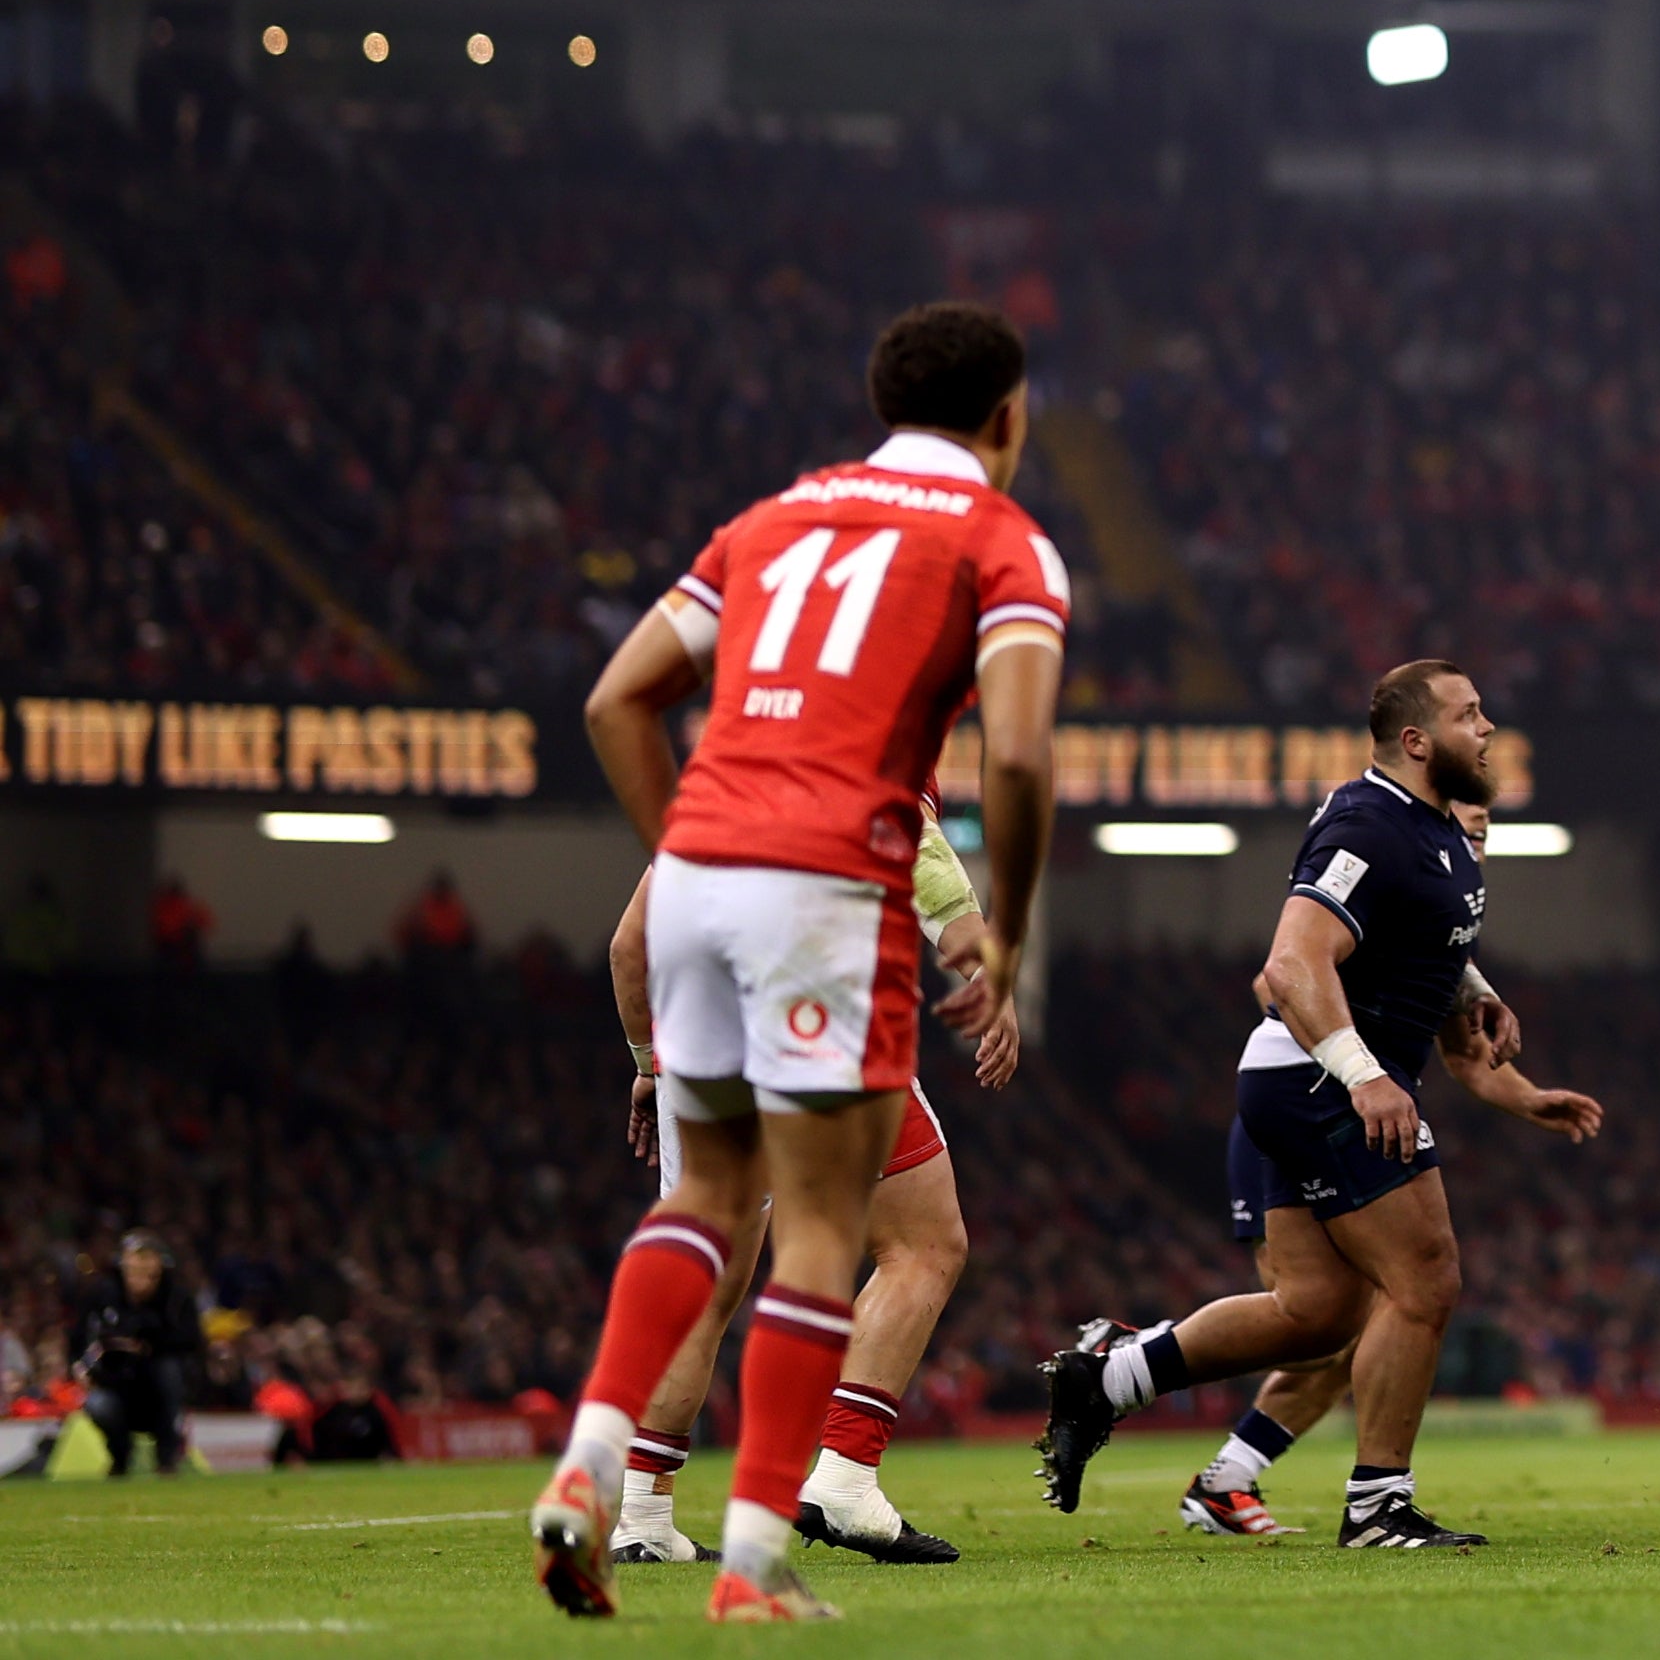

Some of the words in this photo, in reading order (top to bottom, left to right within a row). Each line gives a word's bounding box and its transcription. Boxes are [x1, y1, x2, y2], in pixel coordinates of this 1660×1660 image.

[747, 527, 901, 677] 11
[157, 701, 281, 791] LIKE
[286, 705, 538, 800] PASTIES
[743, 686, 804, 721] DYER
